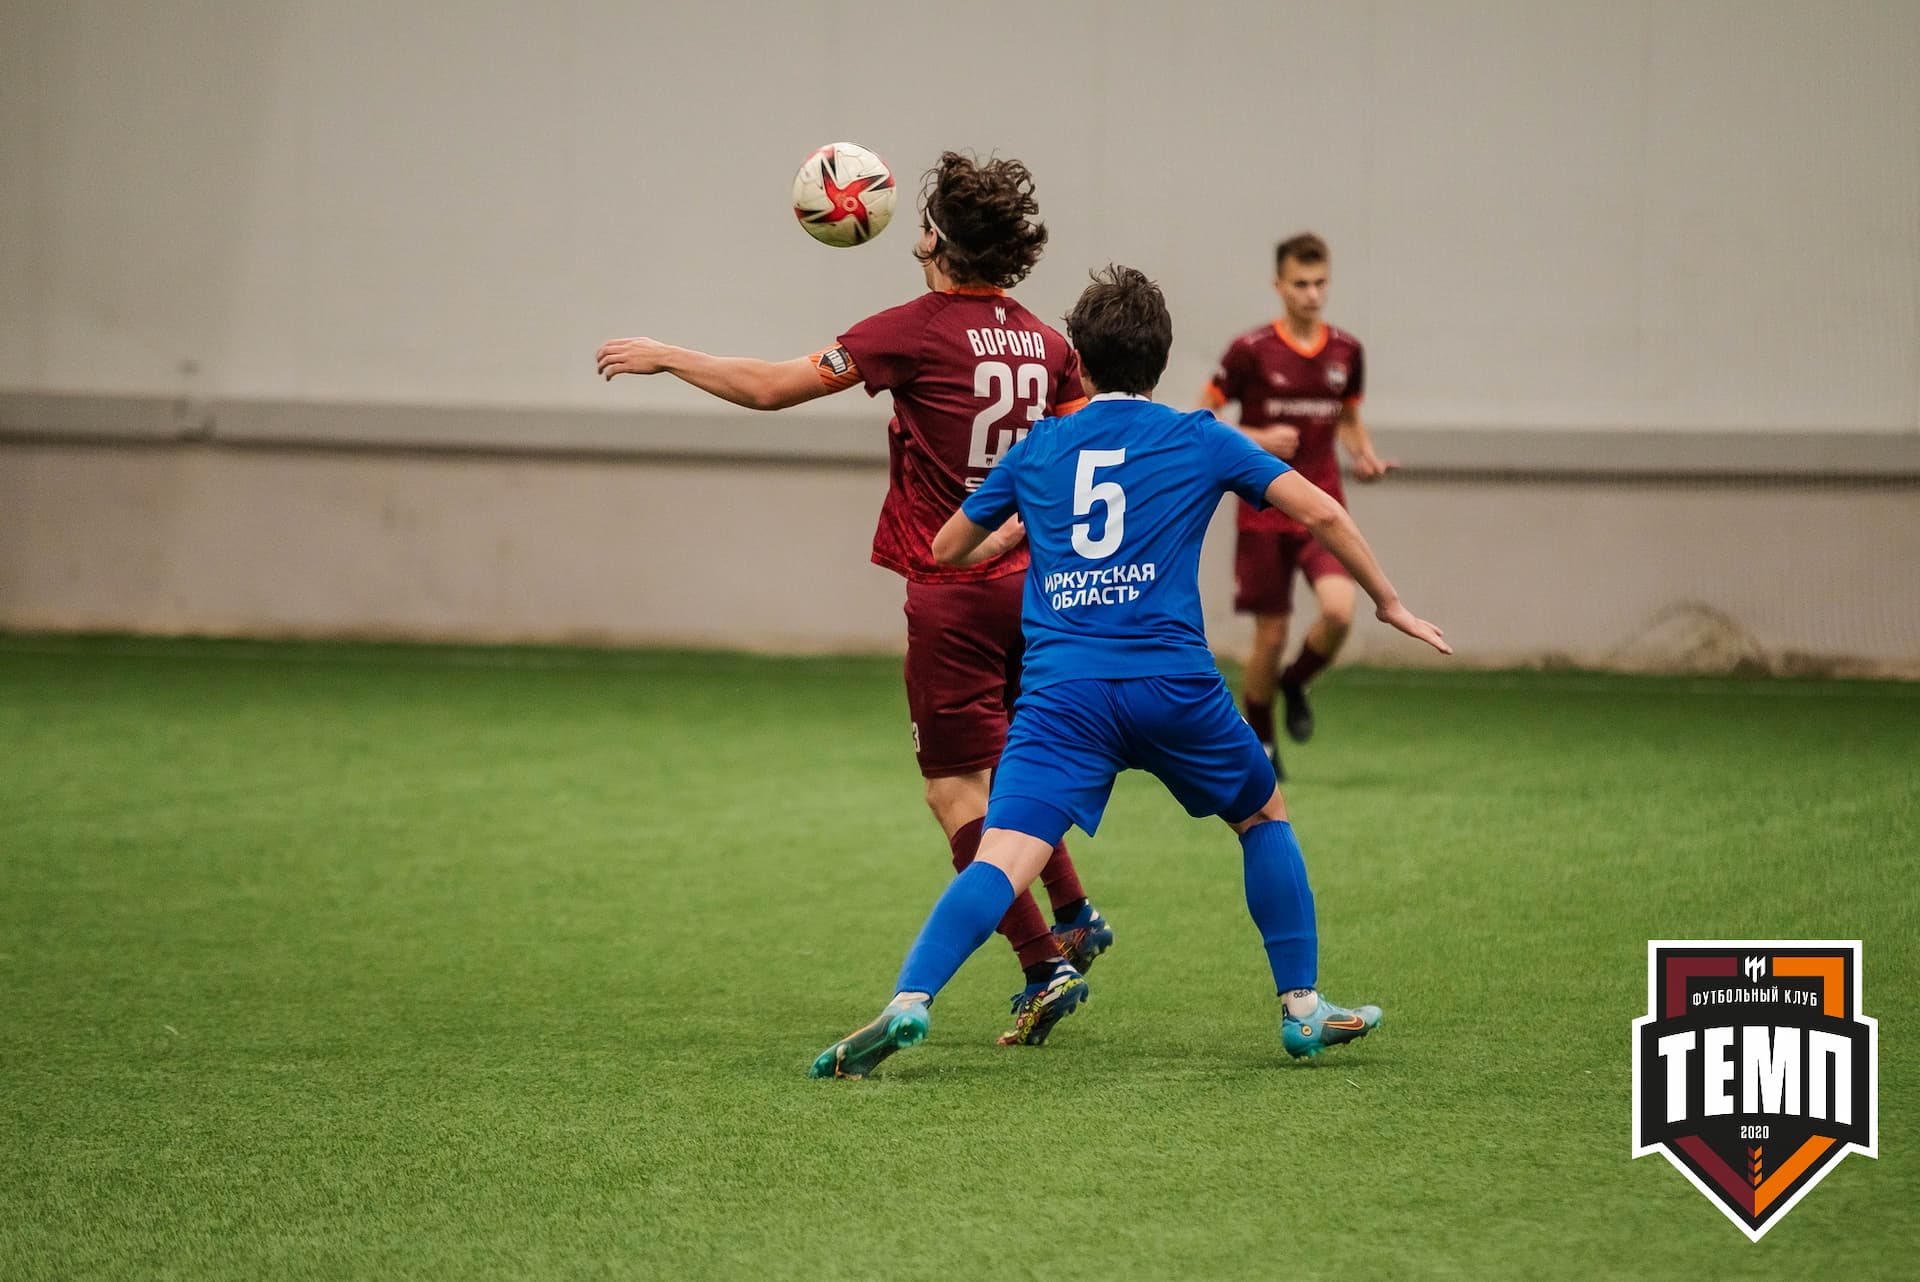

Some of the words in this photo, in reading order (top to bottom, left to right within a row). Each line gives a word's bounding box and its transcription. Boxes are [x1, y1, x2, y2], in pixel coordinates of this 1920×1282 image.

[966, 327, 1046, 360] ВОРОНА
[1071, 447, 1126, 559] 5
[1044, 563, 1155, 593] ИРКУТСКАЯ
[1052, 585, 1139, 611] ОБЛАСТЬ
